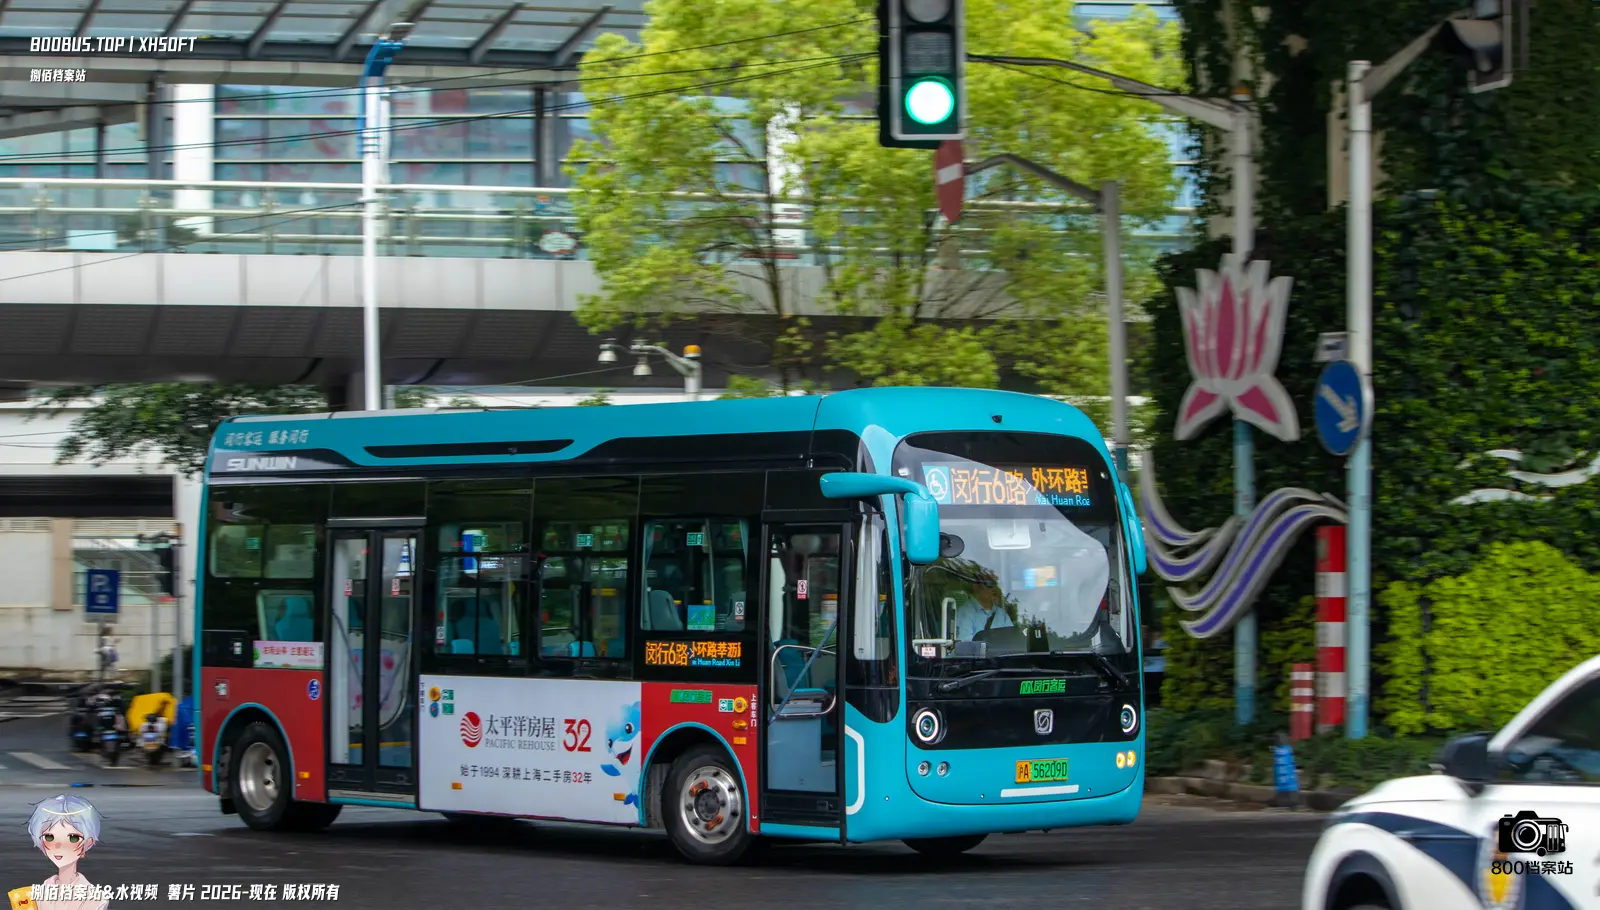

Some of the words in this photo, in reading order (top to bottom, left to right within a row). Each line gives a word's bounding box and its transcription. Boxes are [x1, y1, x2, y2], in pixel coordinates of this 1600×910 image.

[226, 456, 298, 472] SUNWIN
[951, 467, 1027, 506] 闵行6路
[1051, 494, 1073, 506] Huan
[645, 641, 688, 666] 闵行6路
[692, 641, 742, 658] 环路莘沥
[1033, 679, 1066, 694] 闵行客运
[485, 715, 556, 739] 太平洋房屋
[563, 718, 592, 752] 32
[485, 738, 516, 749] PACIFIC
[518, 739, 556, 751] REHOUSE
[460, 764, 500, 779] 始于1994
[502, 766, 593, 784] 深耕上海二手房32年
